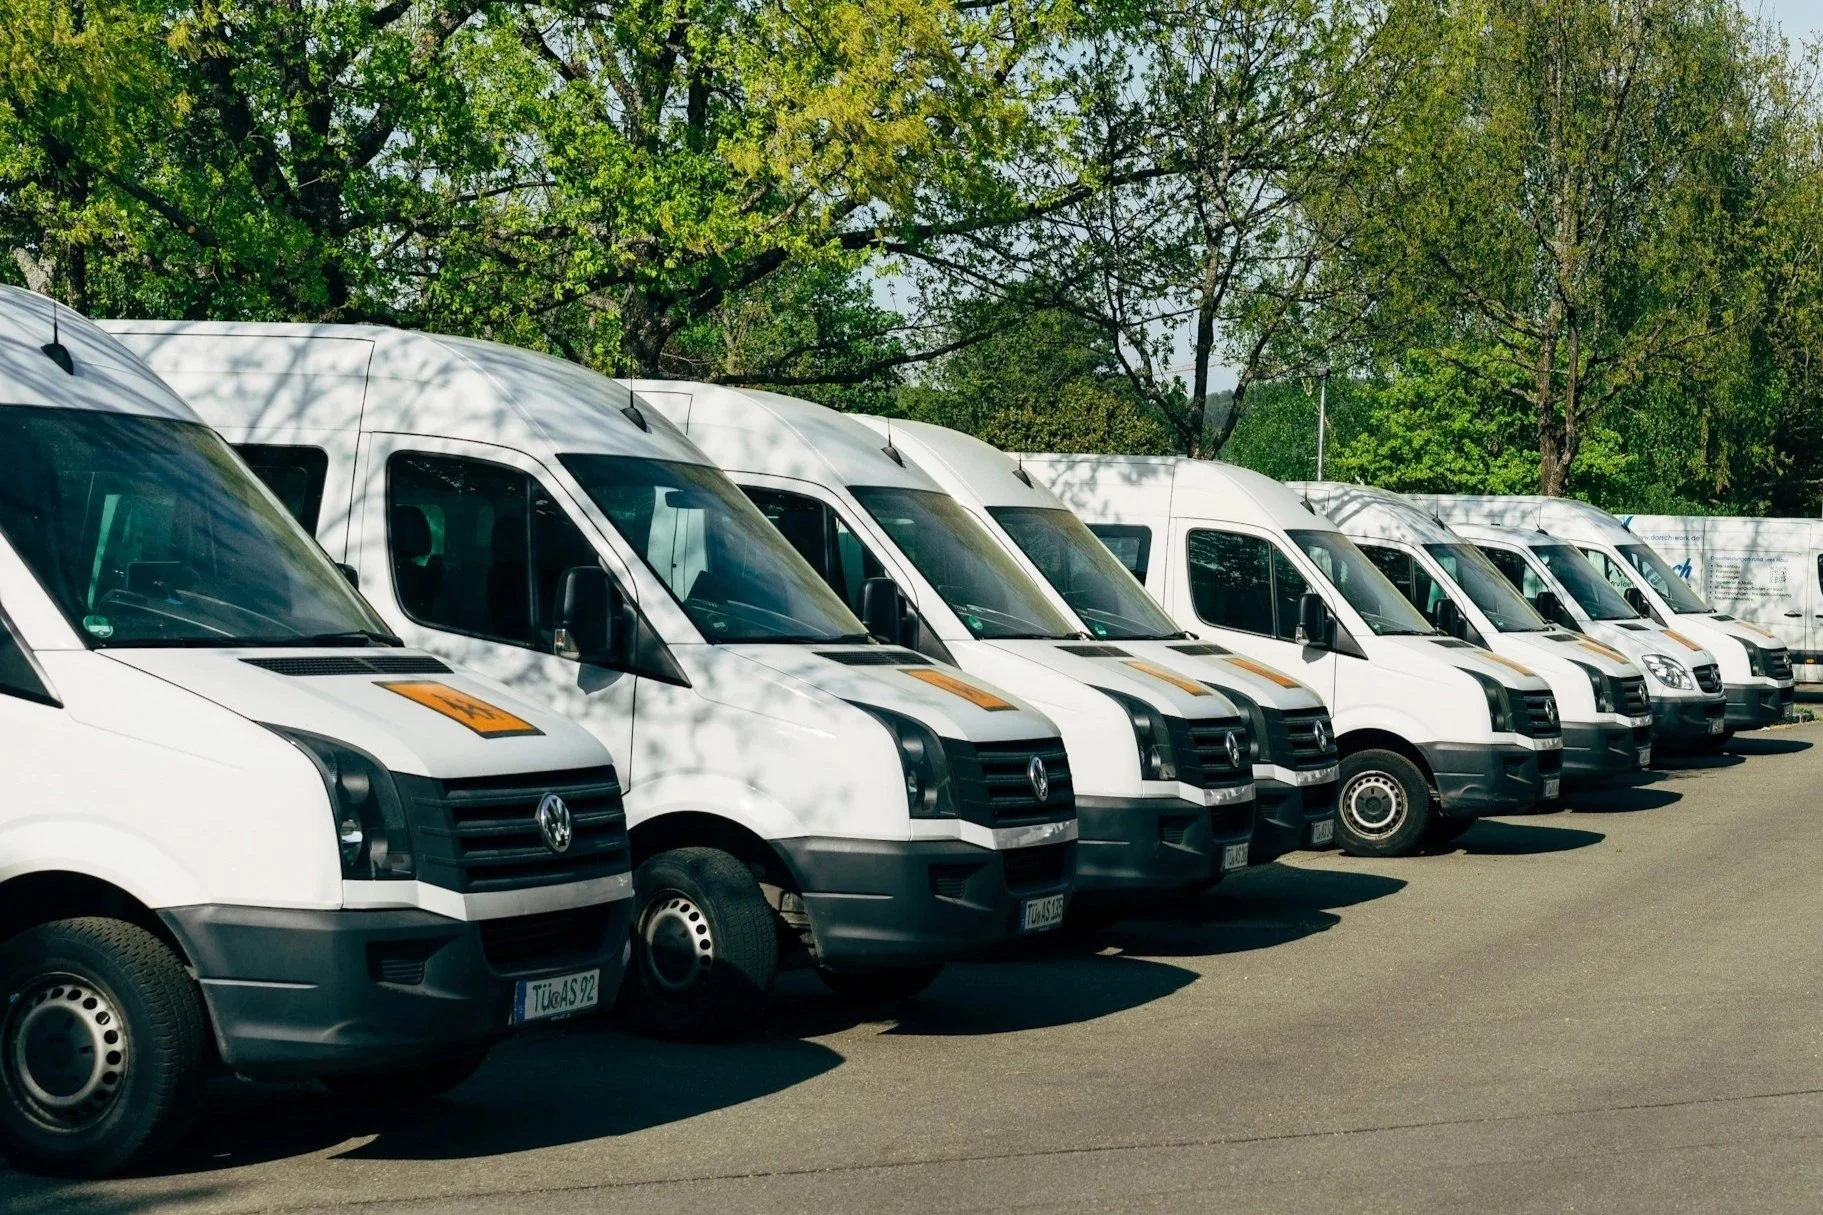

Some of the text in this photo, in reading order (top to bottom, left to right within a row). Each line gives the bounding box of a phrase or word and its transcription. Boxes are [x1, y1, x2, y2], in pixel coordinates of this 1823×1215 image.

[532, 974, 596, 1012] TÜ AS 92
